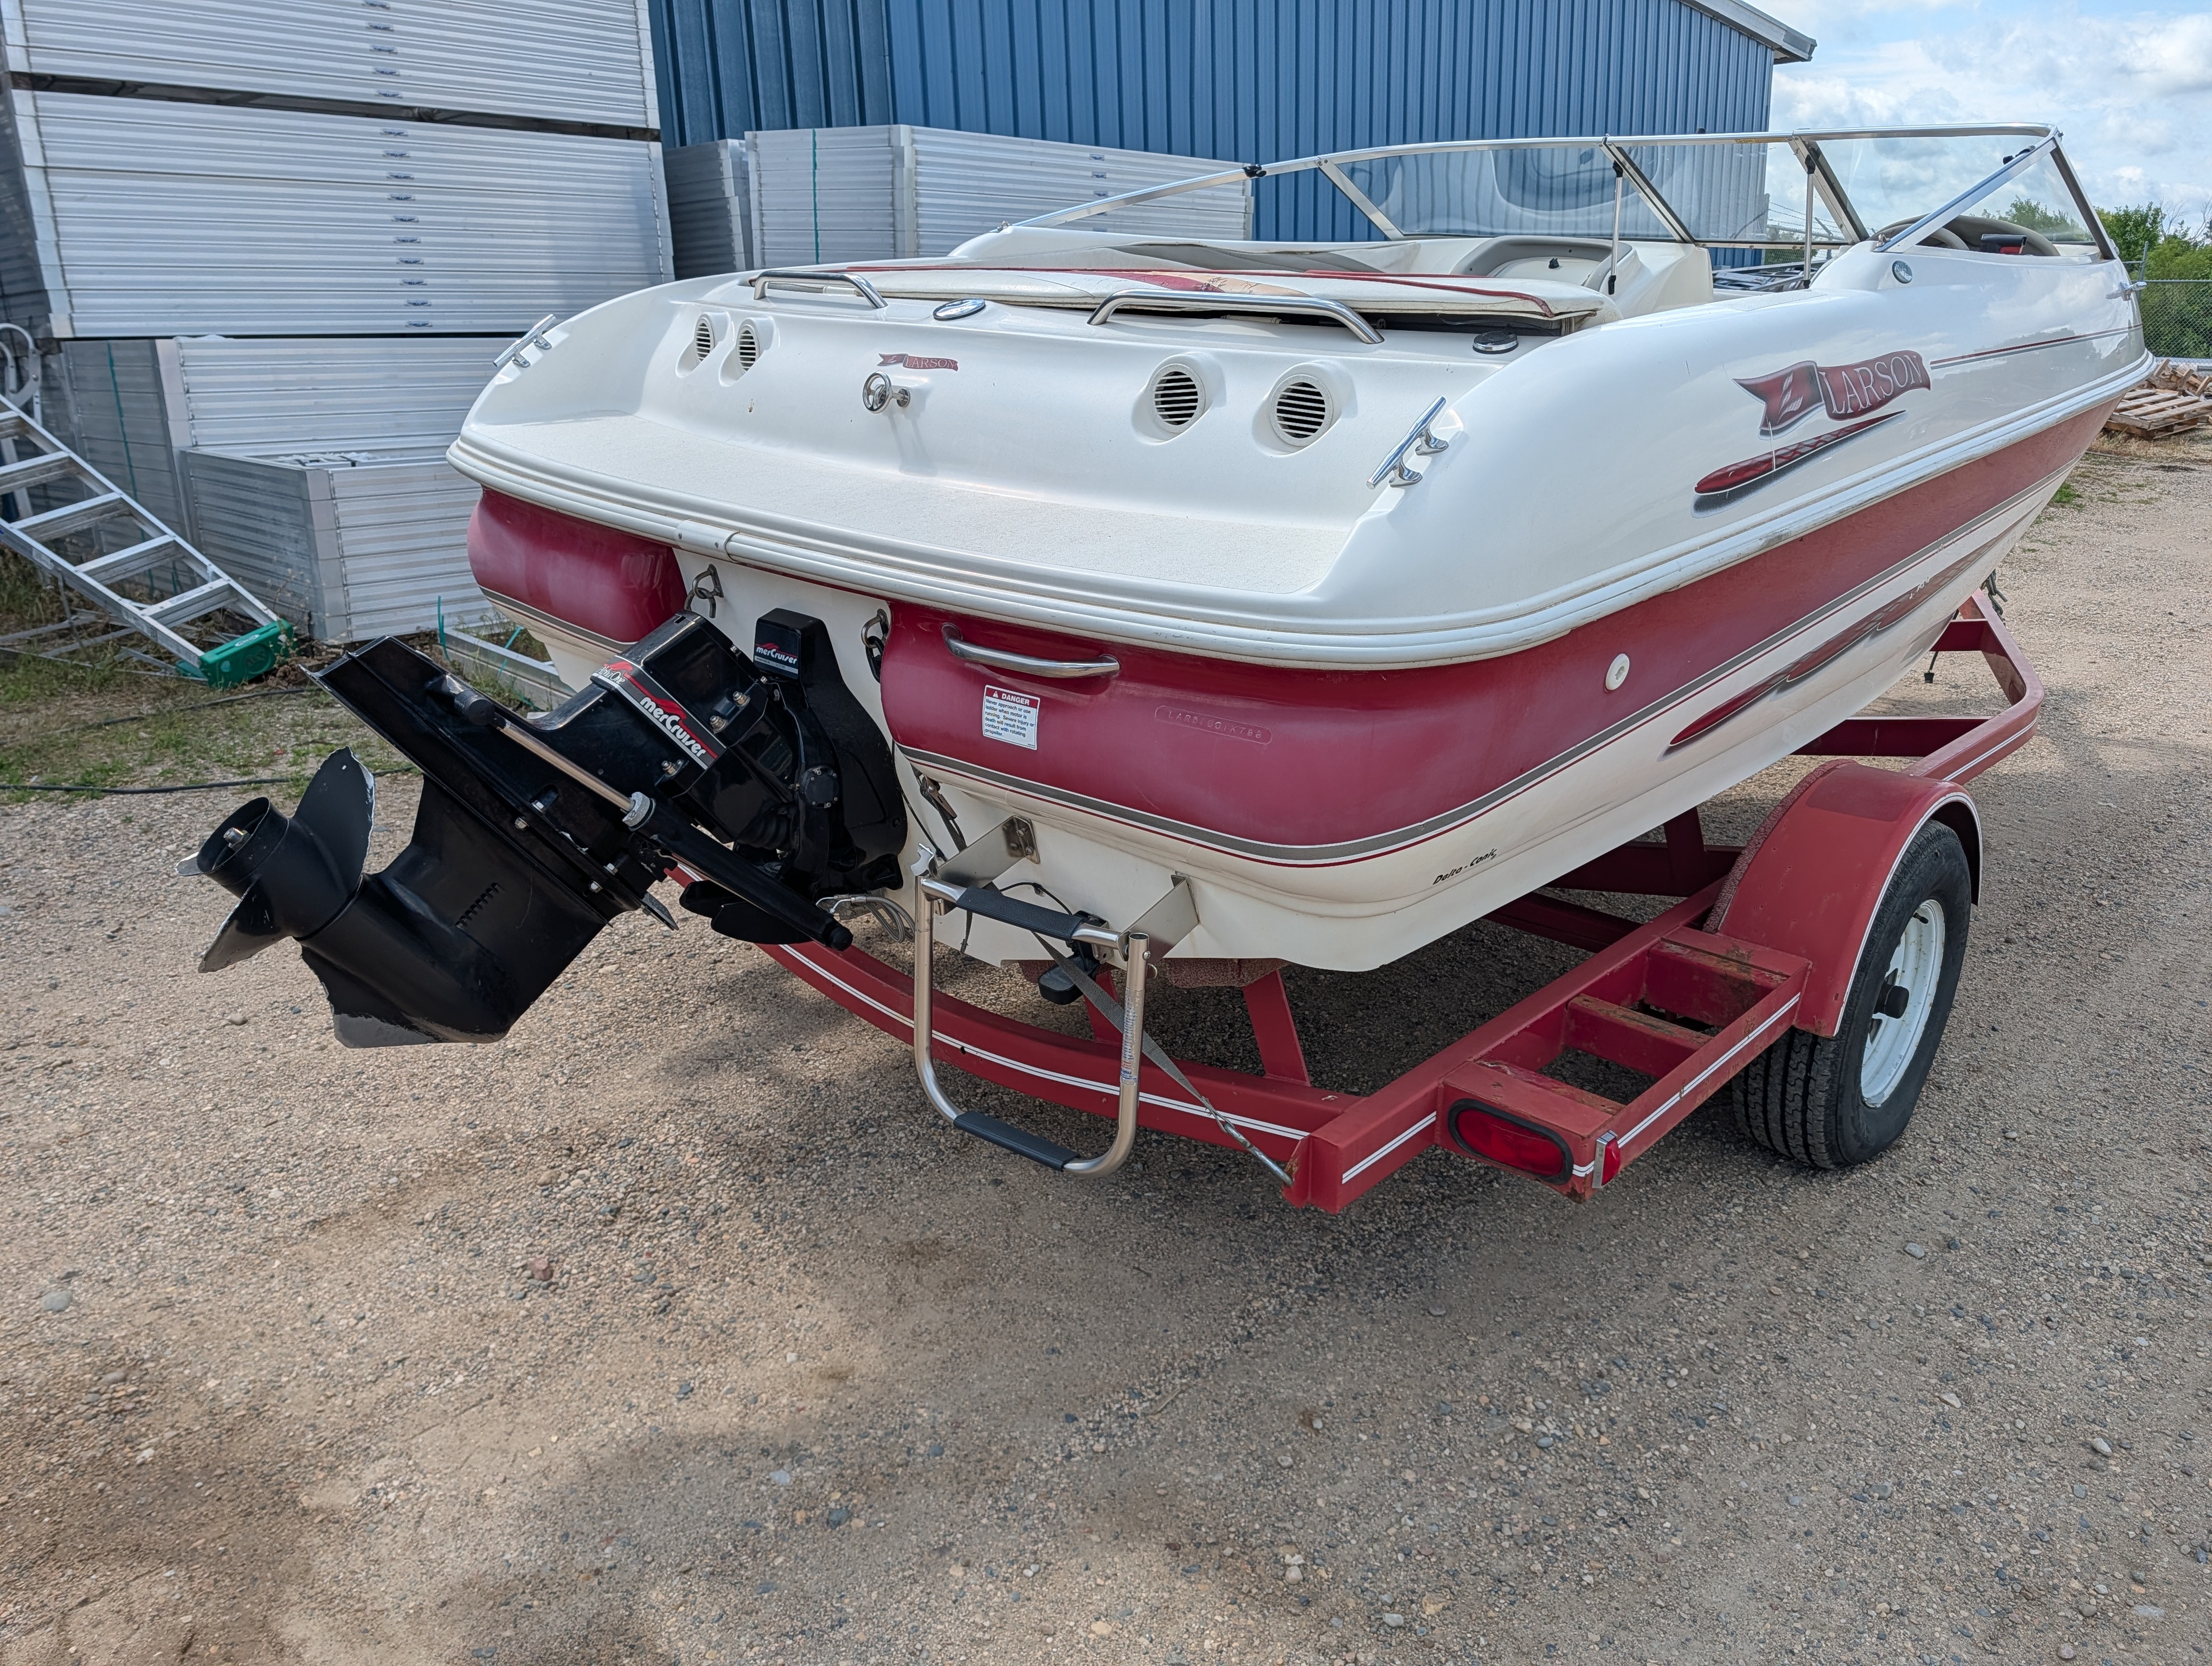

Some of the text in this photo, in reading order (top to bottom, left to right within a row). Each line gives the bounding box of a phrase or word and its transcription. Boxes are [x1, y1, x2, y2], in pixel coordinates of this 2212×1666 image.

[905, 356, 955, 369] LARSON
[1819, 355, 1923, 414] LARSON
[756, 646, 798, 664] merCruiser
[1001, 693, 1030, 706] DANGER
[998, 702, 1017, 711] approach
[985, 711, 1001, 719] running.
[640, 697, 706, 757] merCruiser
[985, 728, 1004, 736] propeller.
[1009, 729, 1026, 738] rotating
